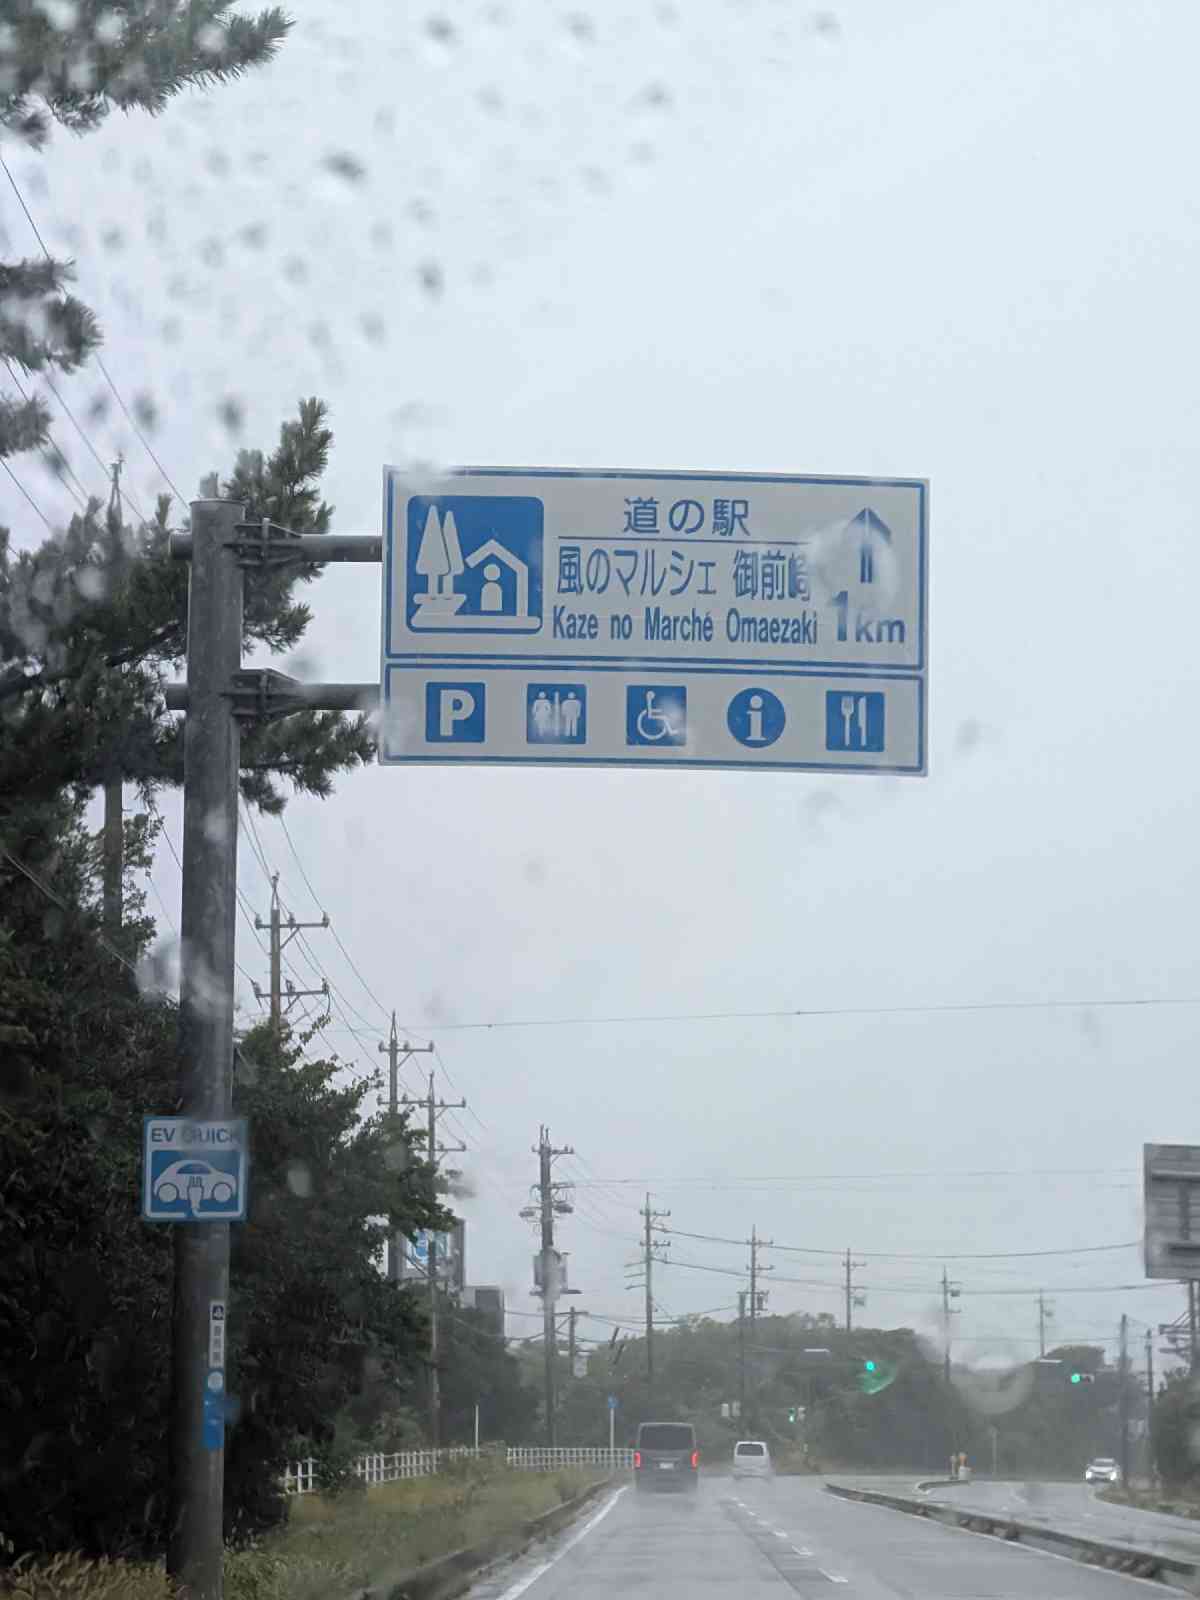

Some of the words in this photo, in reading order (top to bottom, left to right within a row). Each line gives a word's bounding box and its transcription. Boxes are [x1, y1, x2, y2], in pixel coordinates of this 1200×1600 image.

[623, 497, 750, 536] 道の駅
[557, 546, 717, 596] 風のマルシェ
[552, 605, 599, 640] Kaze
[610, 613, 633, 640] no
[644, 607, 714, 642] Marché
[726, 608, 817, 644] Omaezaki
[151, 1127, 176, 1142] EV
